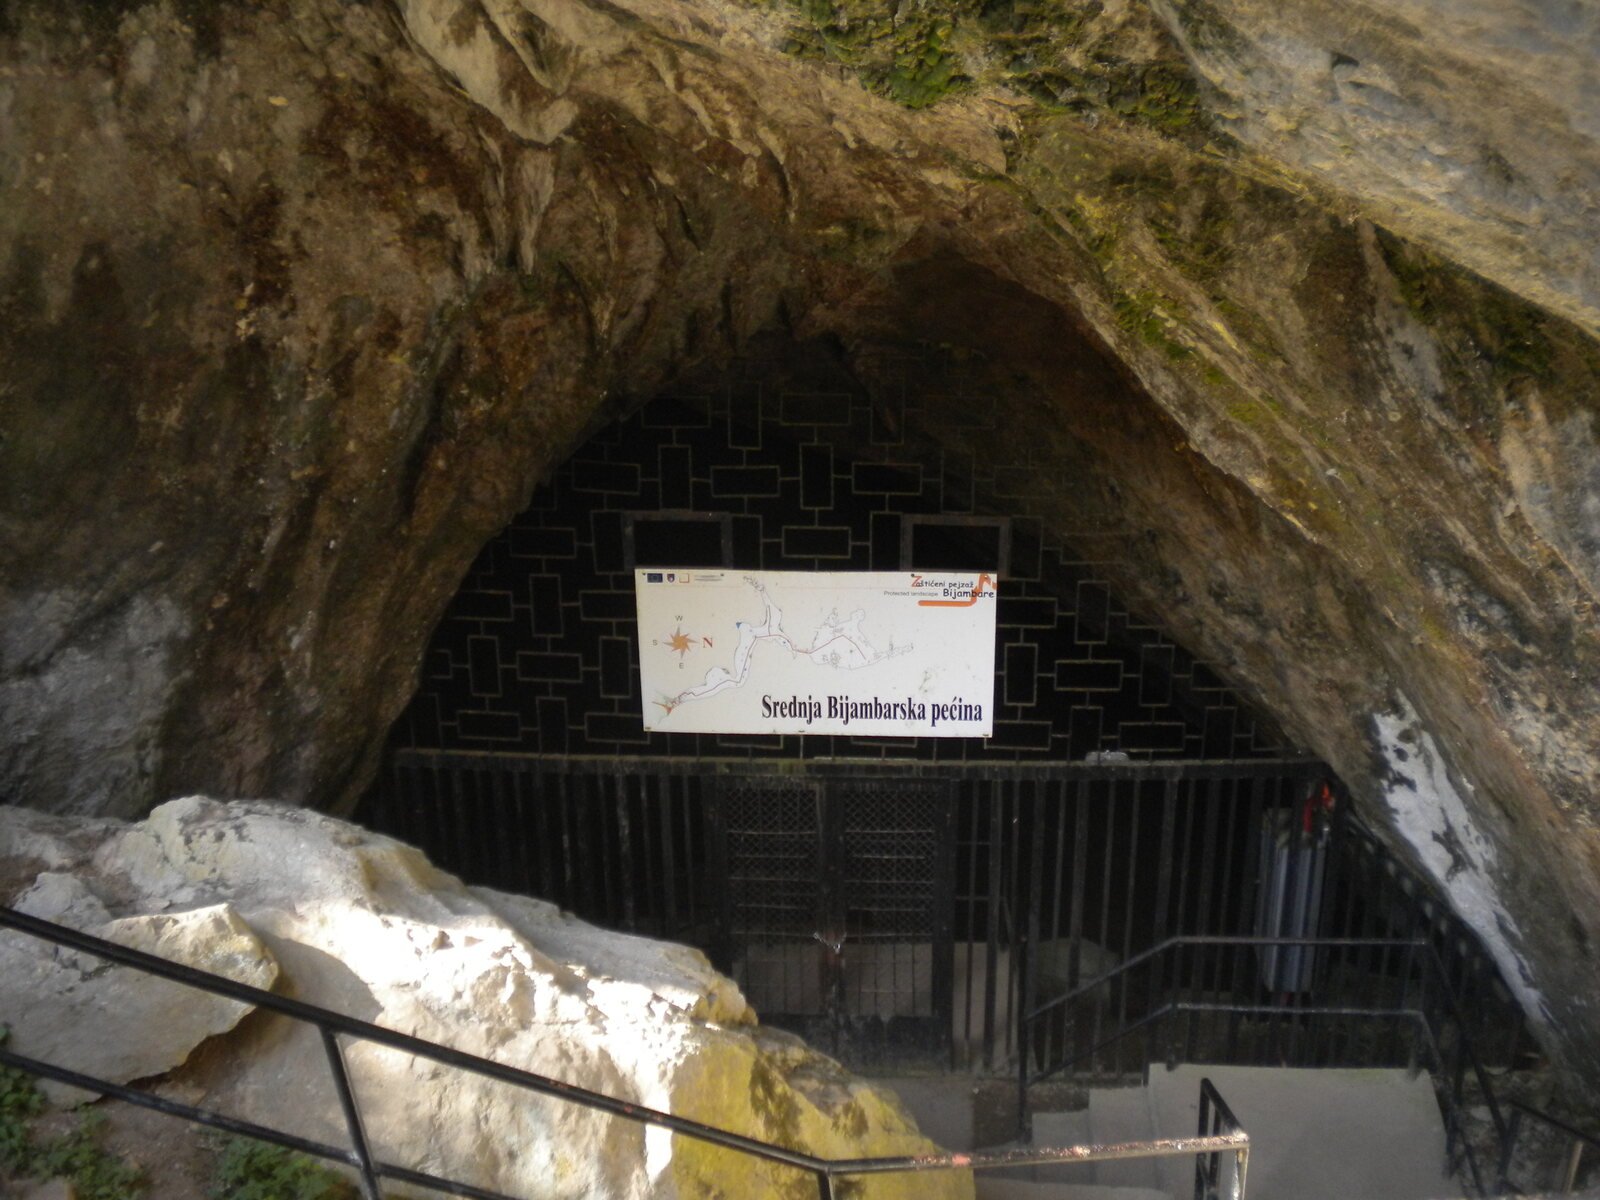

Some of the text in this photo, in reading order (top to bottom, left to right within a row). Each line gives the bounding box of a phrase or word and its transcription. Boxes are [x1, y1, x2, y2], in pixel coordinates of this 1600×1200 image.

[911, 576, 974, 589] Zaštićeni pejzaž
[943, 588, 994, 599] Bijambare
[703, 637, 713, 648] N
[762, 695, 982, 728] Srednja Bijambarska pećina
